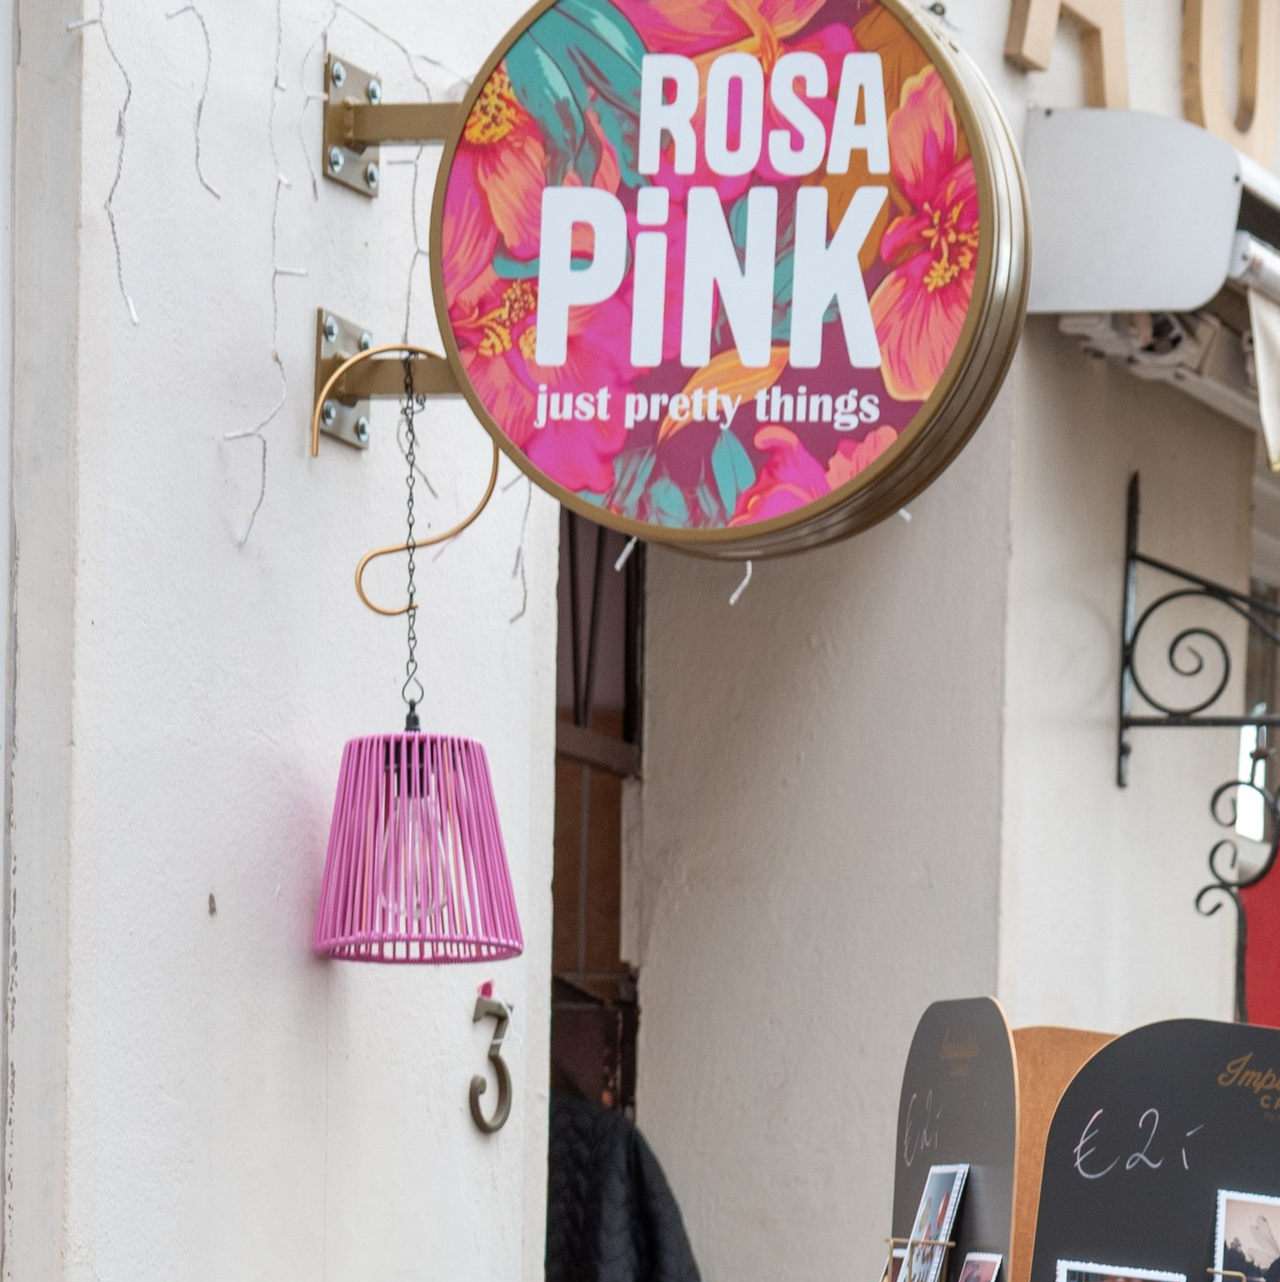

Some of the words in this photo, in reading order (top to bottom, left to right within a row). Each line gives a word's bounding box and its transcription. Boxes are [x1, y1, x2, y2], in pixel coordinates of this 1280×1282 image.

[638, 52, 890, 176] ROSA
[534, 384, 611, 428] just
[625, 388, 742, 429] pretty
[754, 387, 881, 431] things
[469, 997, 513, 1134] 3
